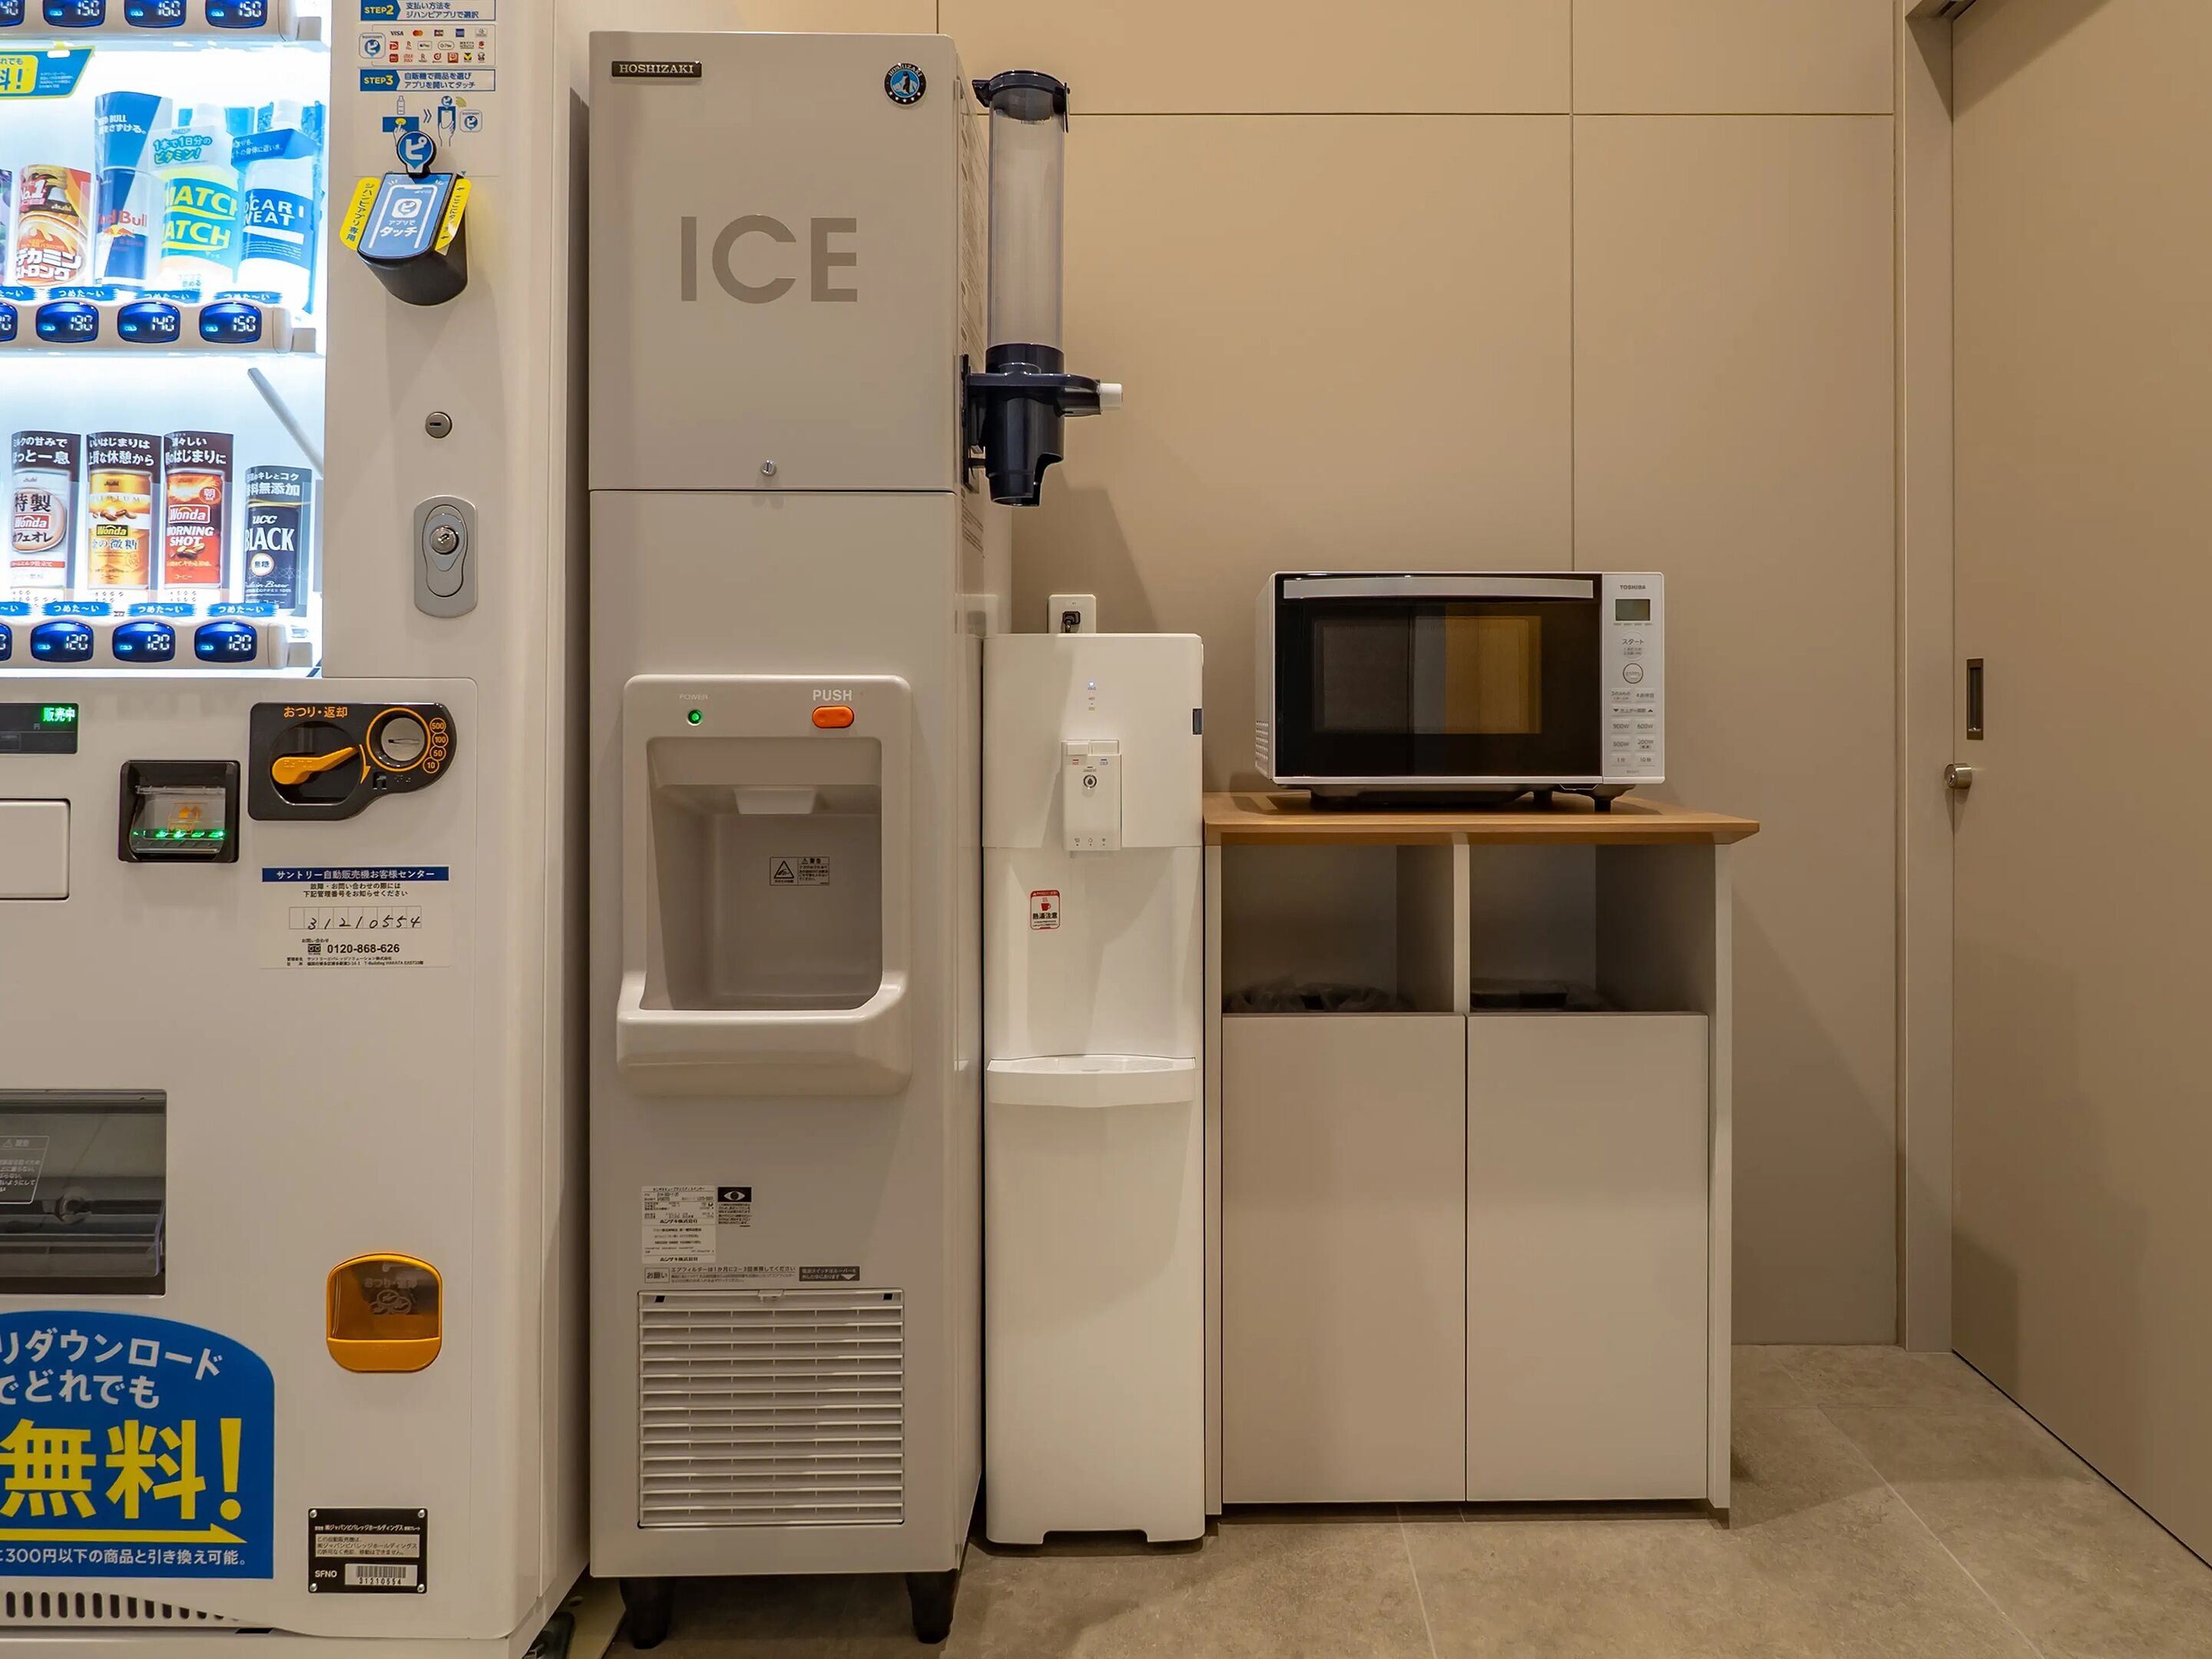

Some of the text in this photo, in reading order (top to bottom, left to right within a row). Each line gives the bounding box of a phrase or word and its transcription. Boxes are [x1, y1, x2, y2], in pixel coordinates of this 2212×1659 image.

[77, 1, 100, 16] 150
[238, 2, 261, 18] 150
[364, 5, 394, 15] STEP2
[406, 11, 479, 19] ジハンピアプリで選択
[619, 64, 694, 75] HOSHIZAKI
[364, 75, 394, 85] STEP3
[405, 72, 472, 81] 自販機で商品を選び
[154, 135, 212, 152] 1本で1日分の
[118, 210, 147, 227] Bull
[380, 227, 418, 237] タッチ
[680, 214, 859, 305] ICE
[152, 316, 175, 332] 140
[233, 316, 256, 332] 150
[15, 493, 51, 513] 特製
[170, 507, 207, 521] Wonda
[97, 525, 127, 536] Wonda
[170, 535, 204, 548] SHOT
[65, 634, 88, 651] 120
[147, 634, 170, 651] 120
[228, 634, 252, 651] 120
[812, 689, 853, 702] PUSH
[43, 707, 76, 722] 販売中
[283, 707, 349, 719] おつり・返却
[426, 761, 436, 770] 10
[276, 869, 435, 880] サントリー自動販売機お客様センター
[326, 944, 400, 954] 0120-868-626
[0, 1417, 242, 1521] 無料!
[314, 1570, 338, 1578] SFNO
